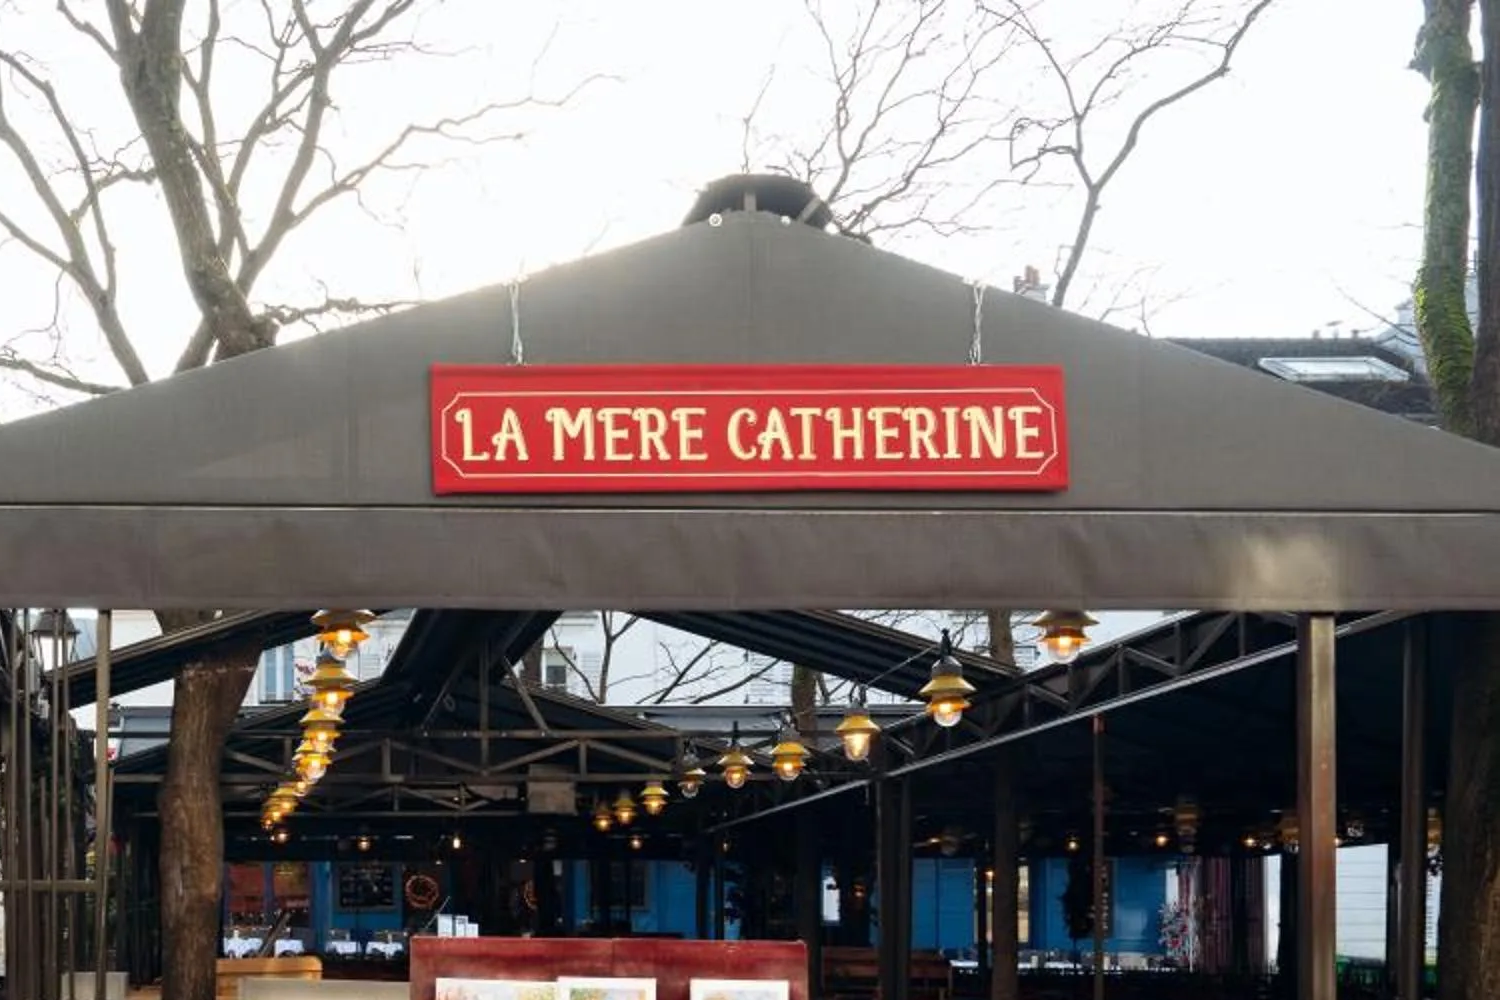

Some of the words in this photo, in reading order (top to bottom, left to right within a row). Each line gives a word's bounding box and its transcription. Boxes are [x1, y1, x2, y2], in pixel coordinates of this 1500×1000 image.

[454, 407, 529, 462] LA
[544, 406, 708, 462] MERE
[727, 404, 1045, 461] CATHERINE
